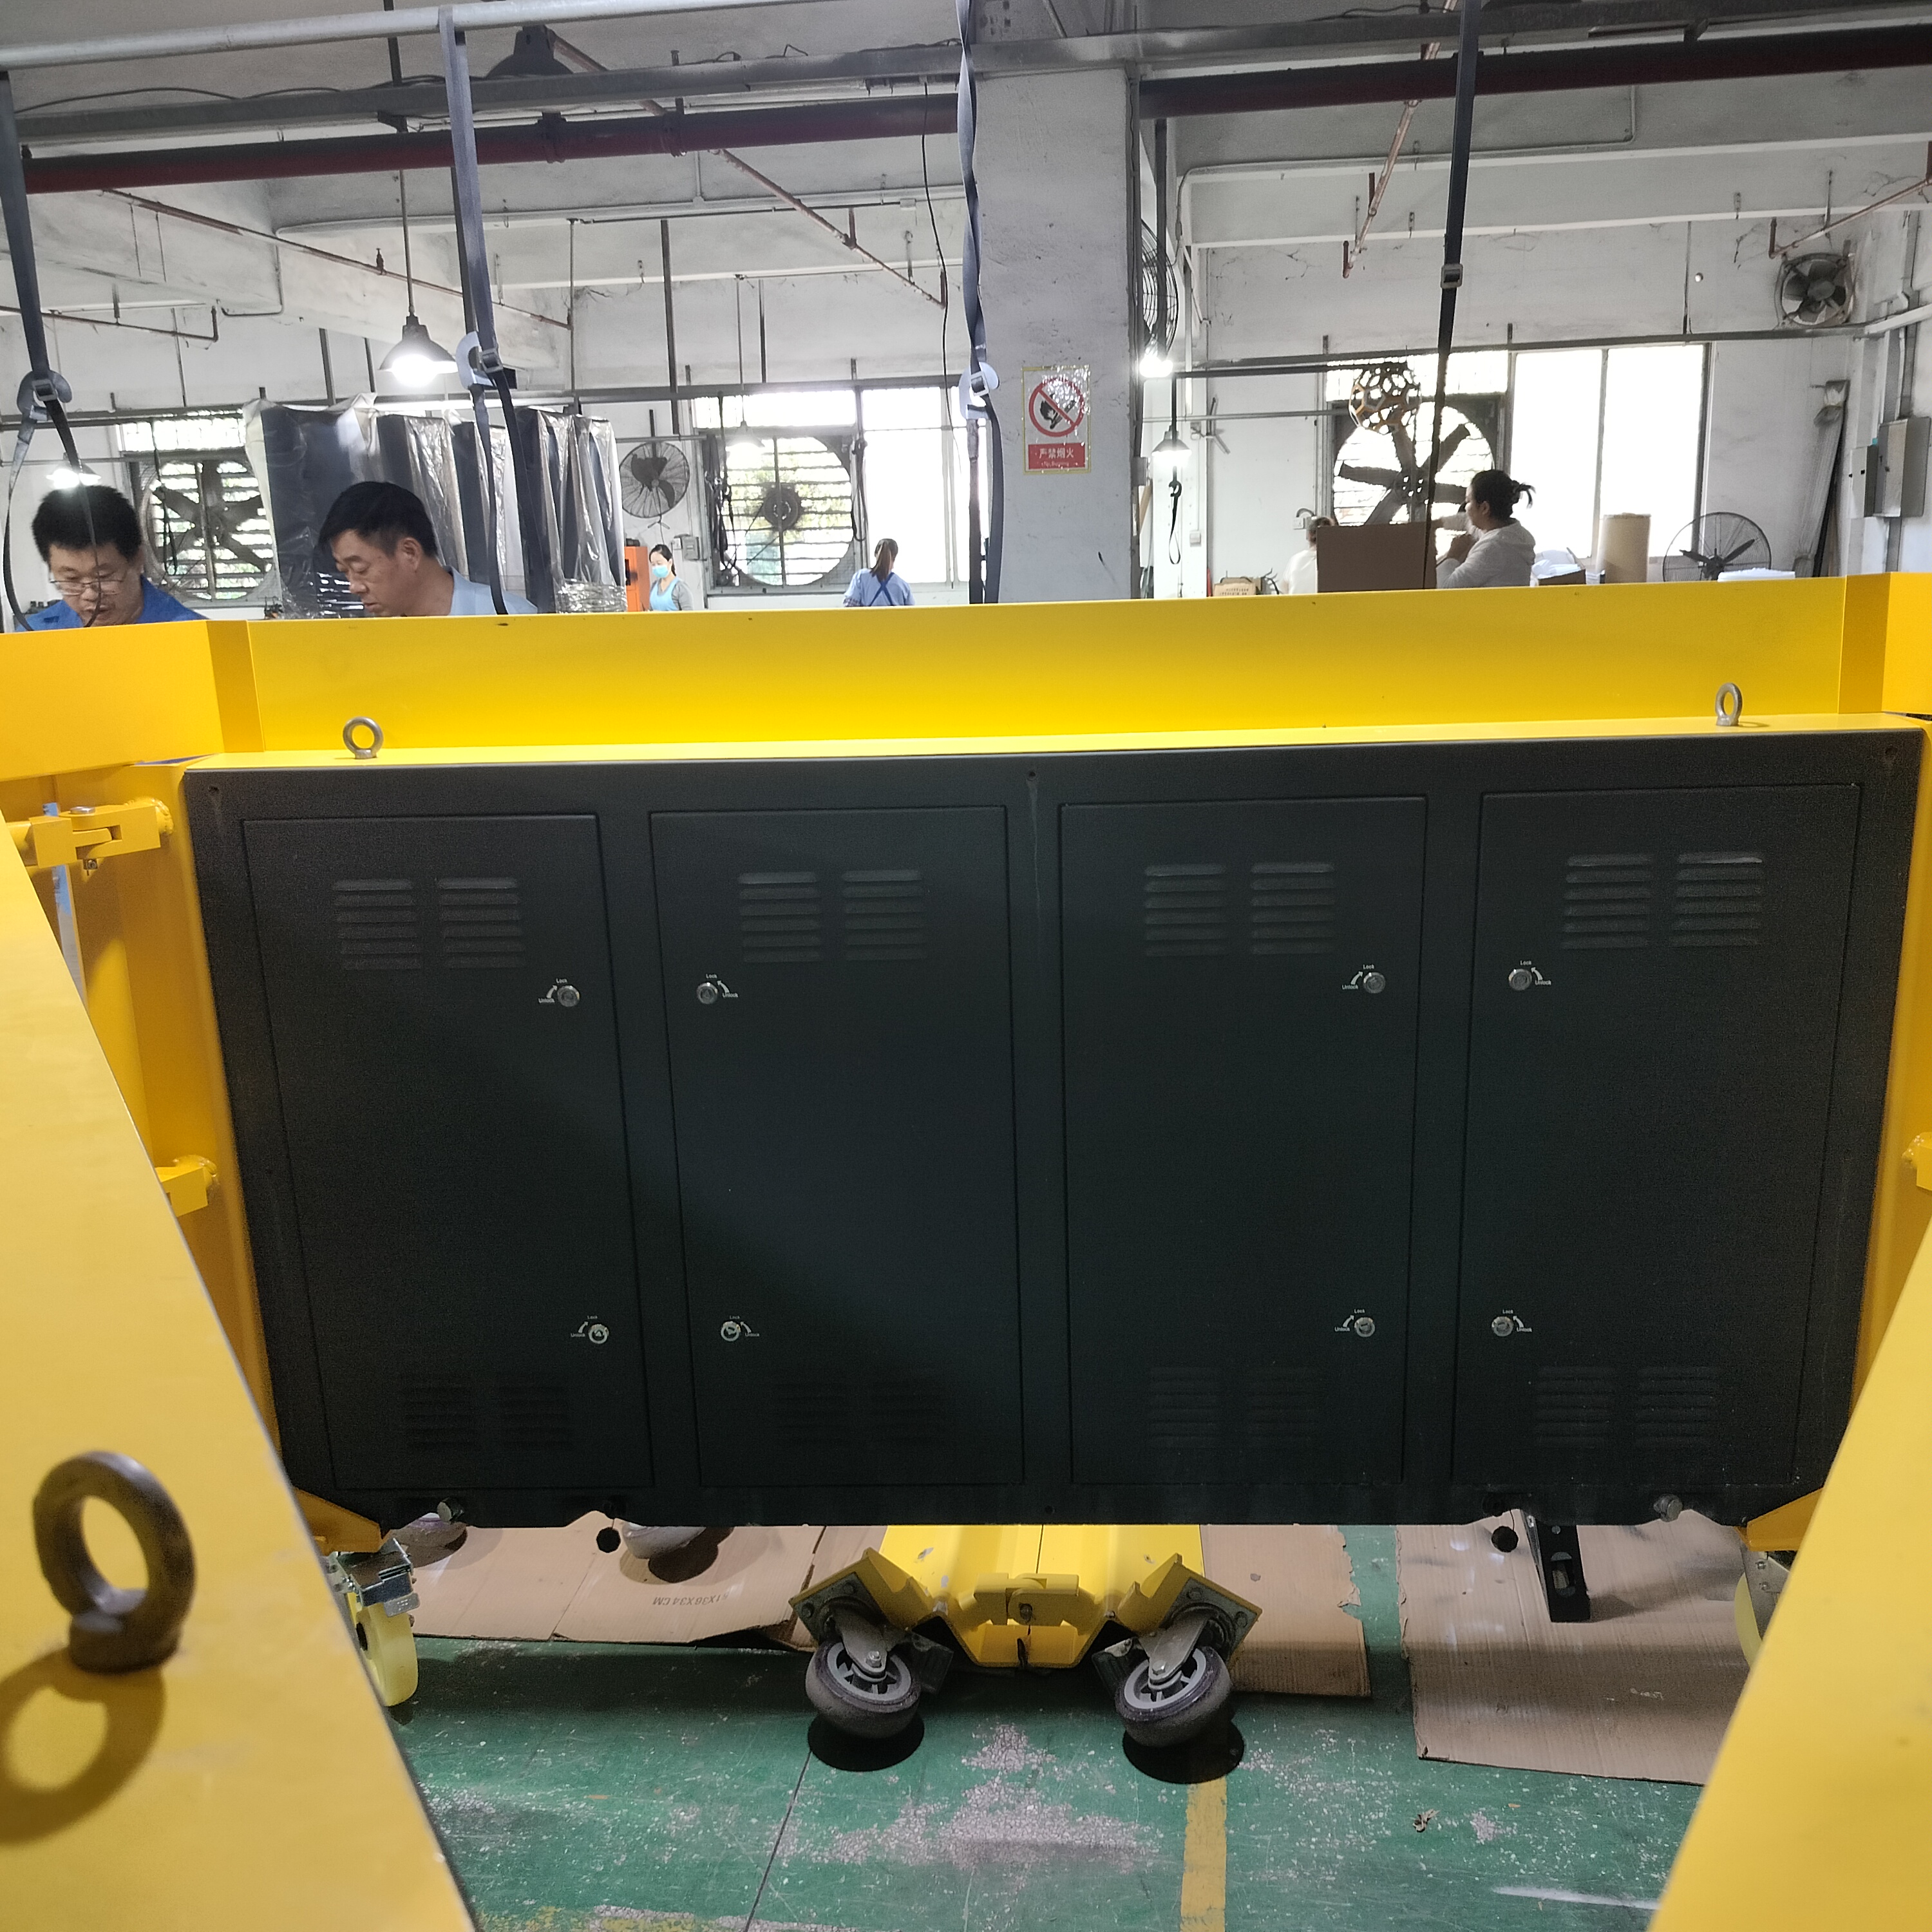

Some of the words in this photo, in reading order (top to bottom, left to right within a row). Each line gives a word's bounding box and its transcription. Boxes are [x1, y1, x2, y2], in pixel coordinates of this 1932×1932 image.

[1039, 447, 1074, 459] 严禁烟火
[653, 1596, 670, 1605] CM
